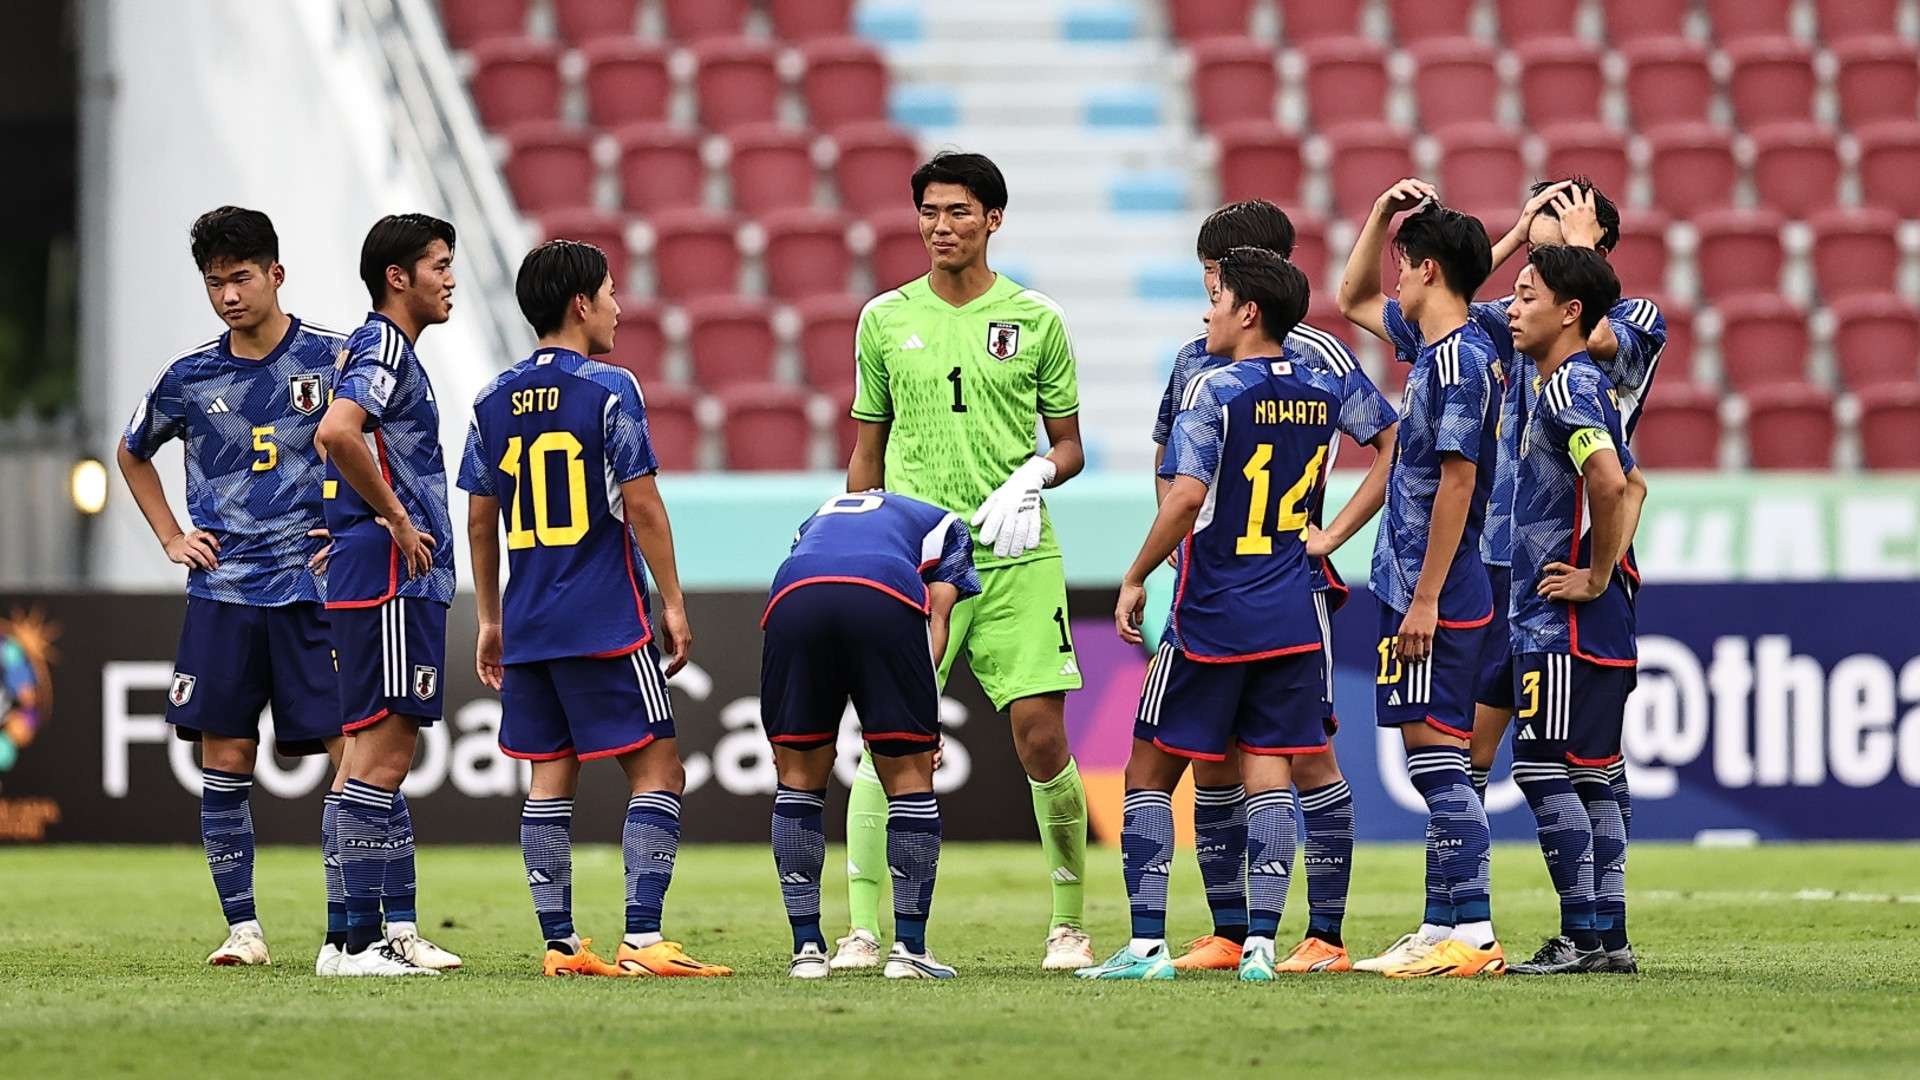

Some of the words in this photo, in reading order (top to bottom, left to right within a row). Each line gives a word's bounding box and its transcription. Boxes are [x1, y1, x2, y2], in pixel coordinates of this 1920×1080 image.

[511, 387, 560, 416] SATO
[946, 366, 968, 413] 1
[1255, 400, 1328, 426] NAWATA
[252, 426, 277, 472] 5
[498, 431, 590, 550] 10
[1235, 443, 1328, 555] 14
[1053, 606, 1072, 653] 1
[1518, 671, 1541, 719] 3
